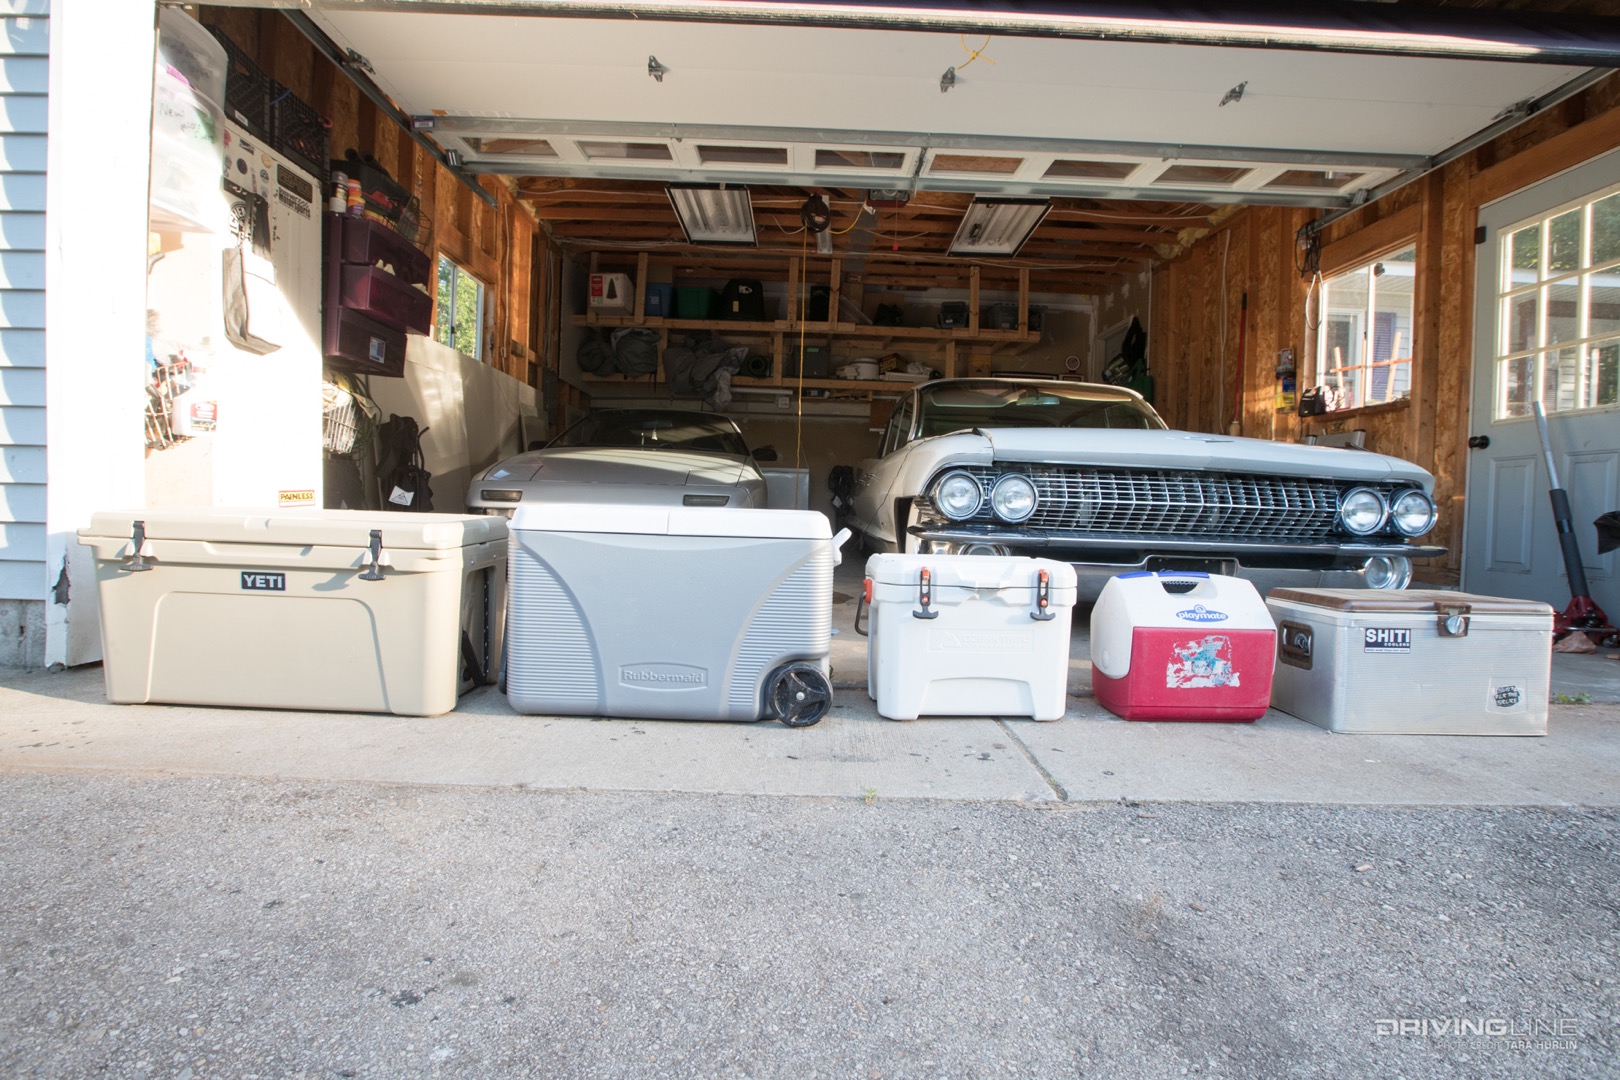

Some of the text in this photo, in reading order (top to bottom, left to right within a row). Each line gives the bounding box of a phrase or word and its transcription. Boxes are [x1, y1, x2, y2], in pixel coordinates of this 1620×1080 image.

[280, 492, 314, 501] PAINLESS
[241, 574, 283, 588] YETI
[1178, 611, 1227, 620] playmate
[1365, 629, 1410, 643] SHITI
[622, 670, 705, 684] Rubbermaid
